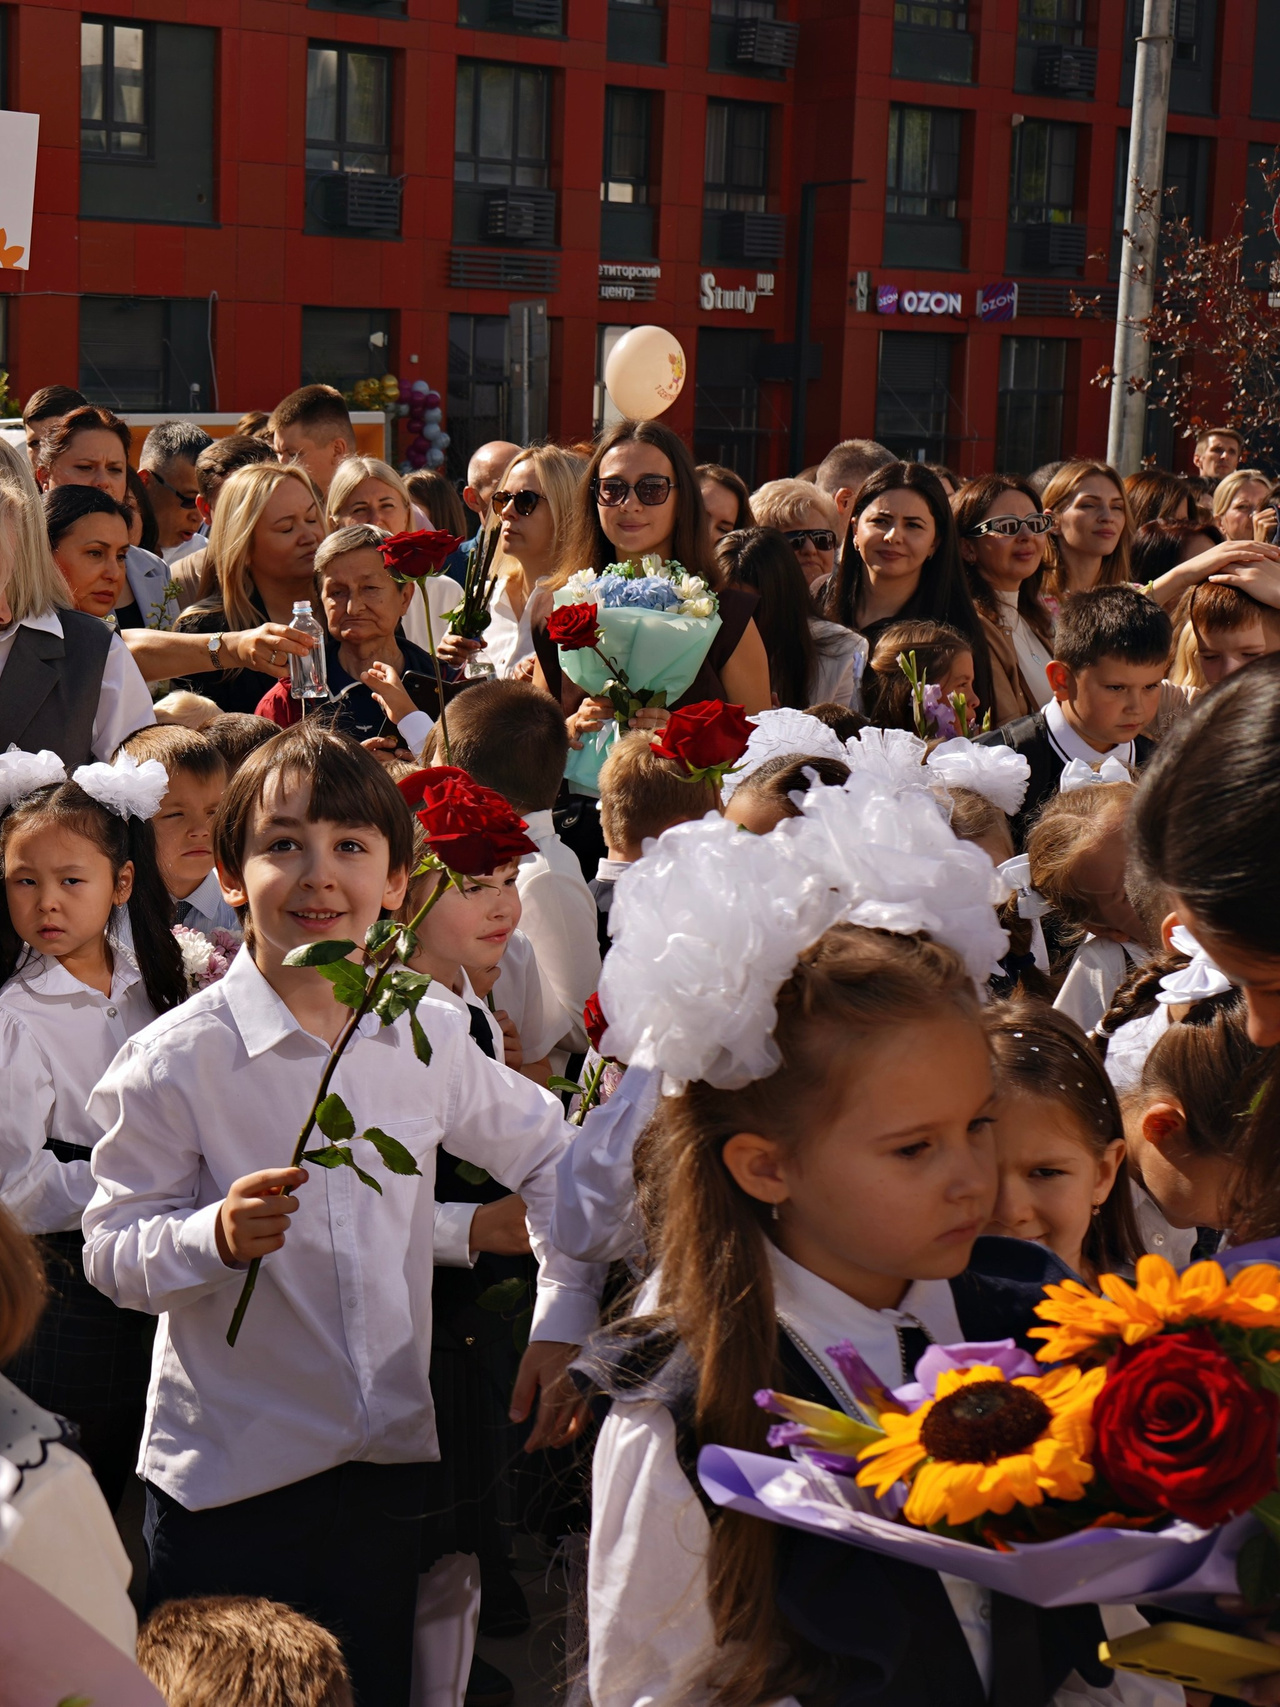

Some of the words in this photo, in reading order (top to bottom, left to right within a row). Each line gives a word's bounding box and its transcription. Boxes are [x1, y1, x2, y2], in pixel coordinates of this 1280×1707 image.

[601, 286, 635, 301] центр
[700, 272, 756, 314] Study
[903, 291, 962, 314] OZON
[981, 292, 1015, 313] OZON
